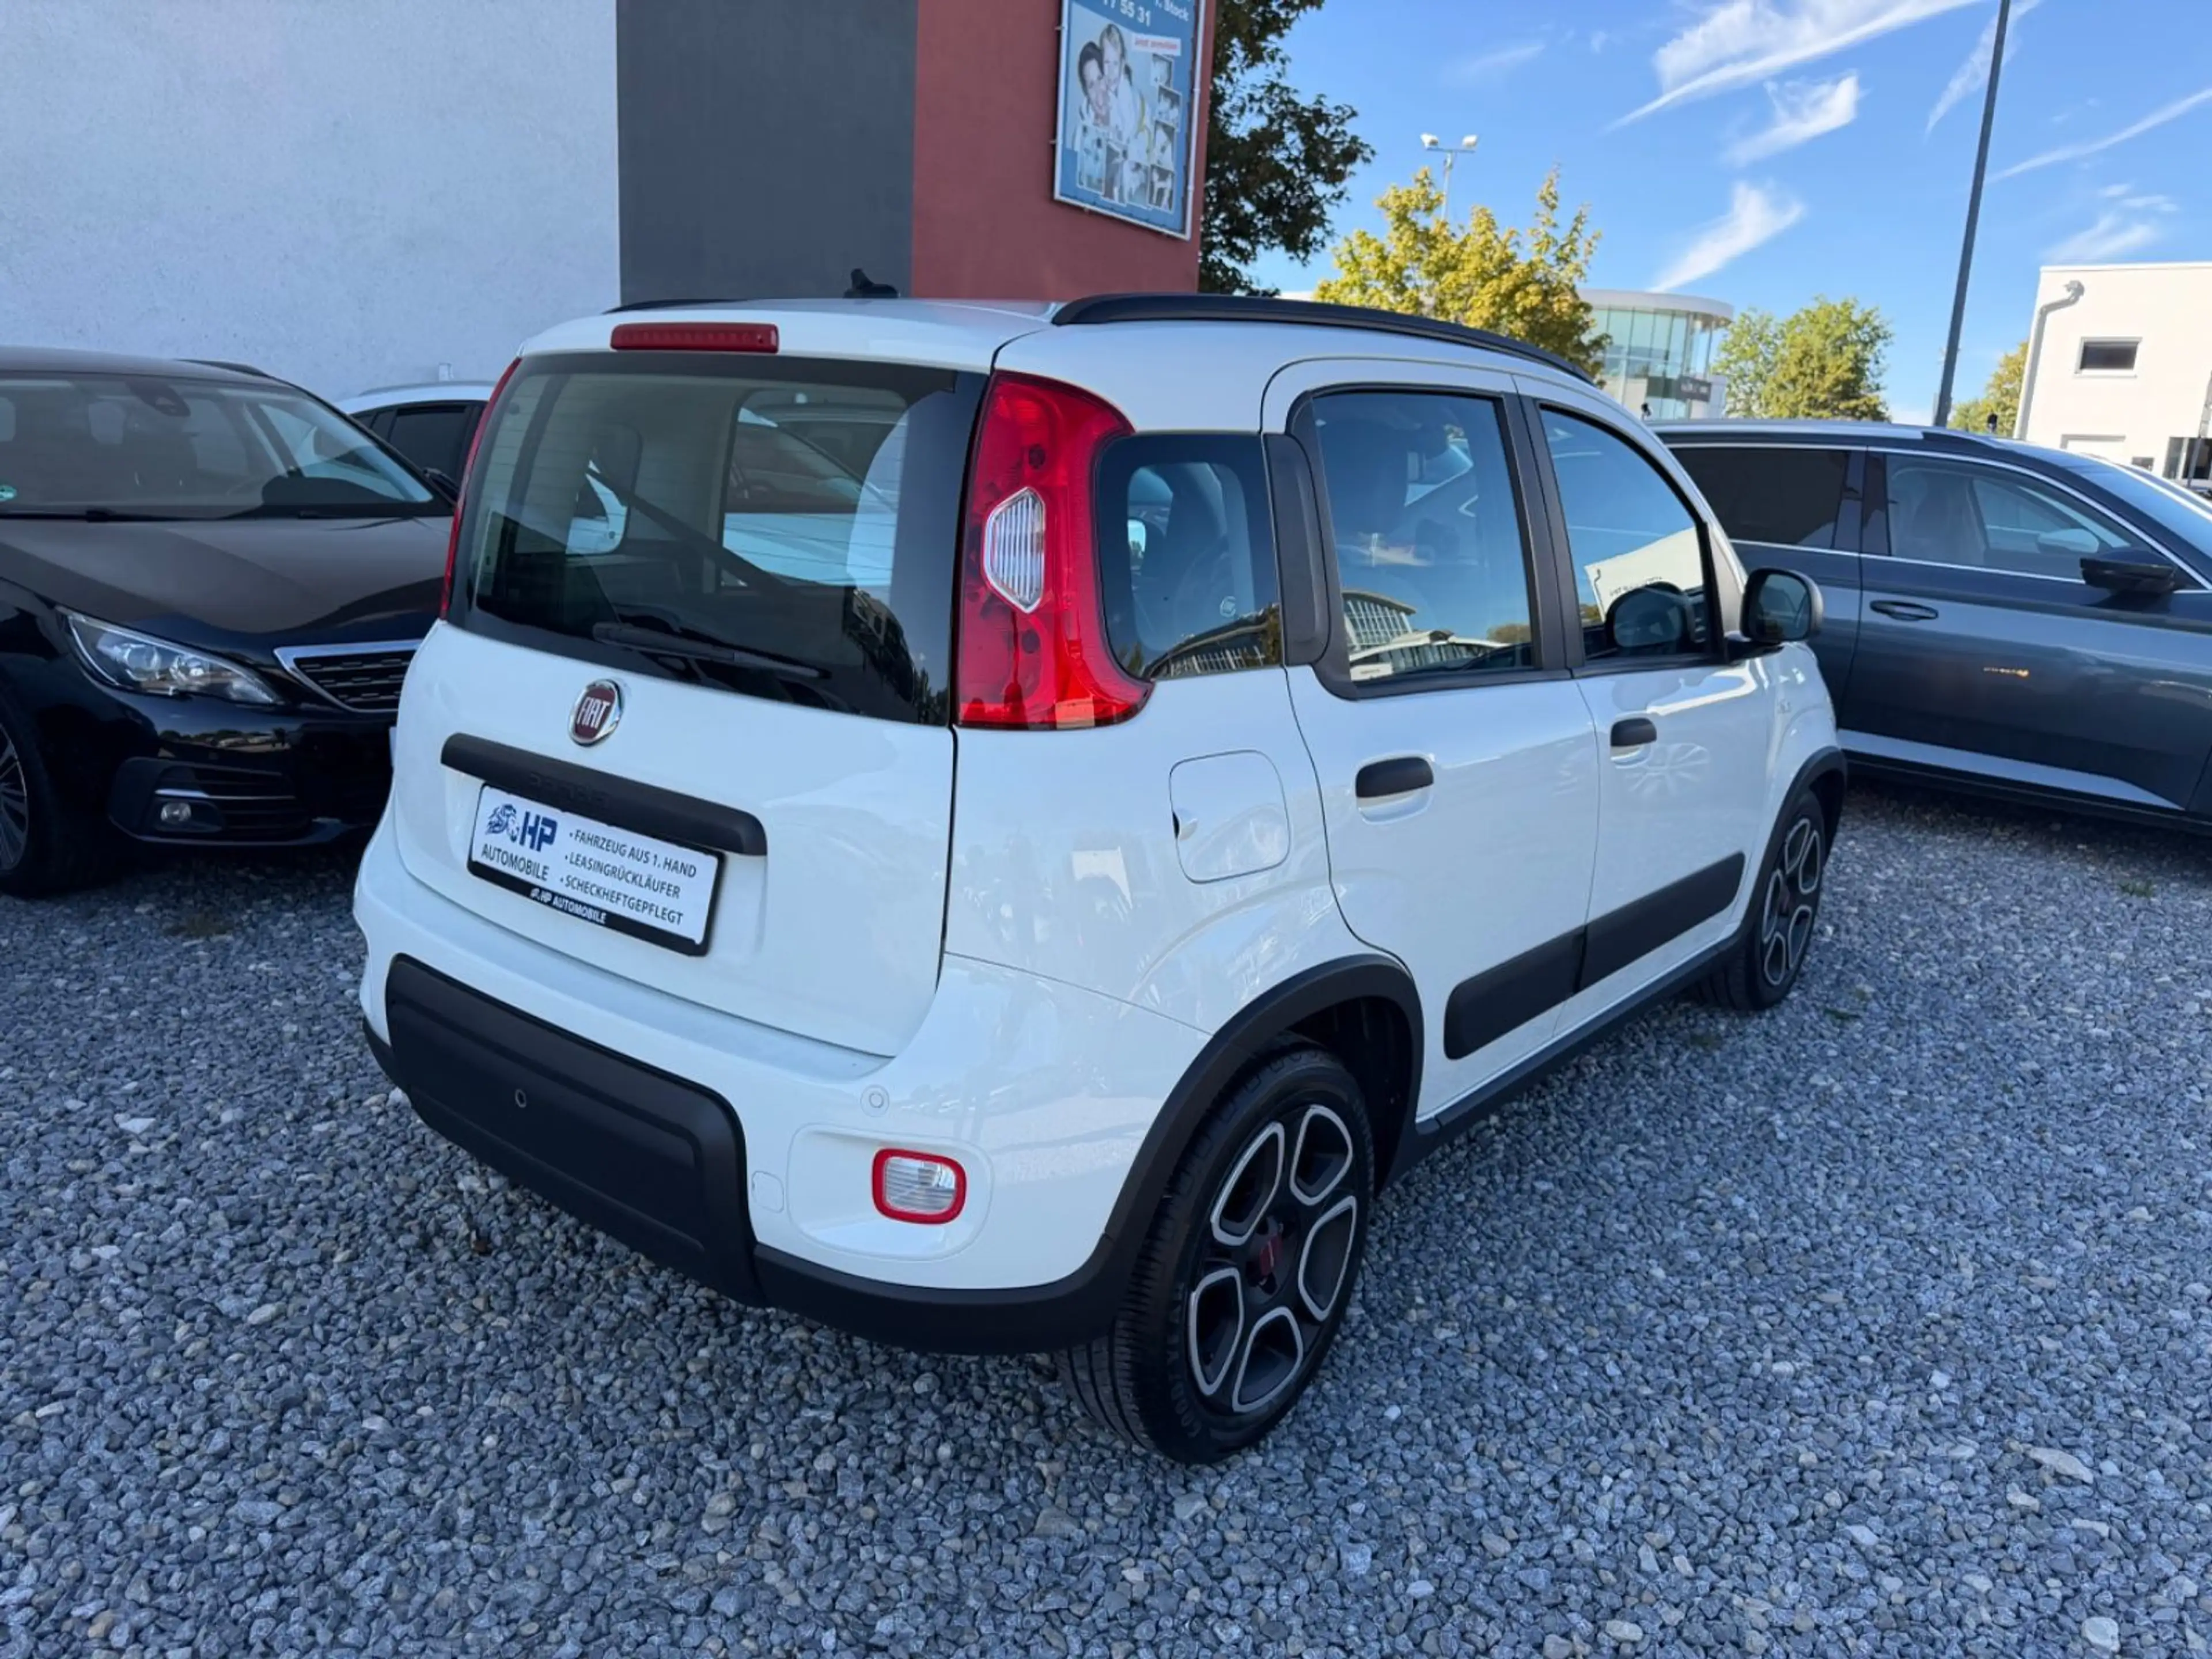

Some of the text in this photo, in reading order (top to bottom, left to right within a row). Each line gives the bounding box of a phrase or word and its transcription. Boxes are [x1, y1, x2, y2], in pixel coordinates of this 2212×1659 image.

[1137, 6, 1151, 27] 31
[576, 696, 611, 729] FIAT
[519, 810, 558, 852] HP
[481, 843, 550, 882] AUTOMOBILE
[574, 829, 697, 878] FAHRZEUG AUS 1. HAND
[569, 851, 681, 899] LEASINGRÜCKLÄUFER
[552, 895, 608, 924] AUTOMOBILE
[565, 874, 684, 926] SCHECKHEFTGEPFLEGT
